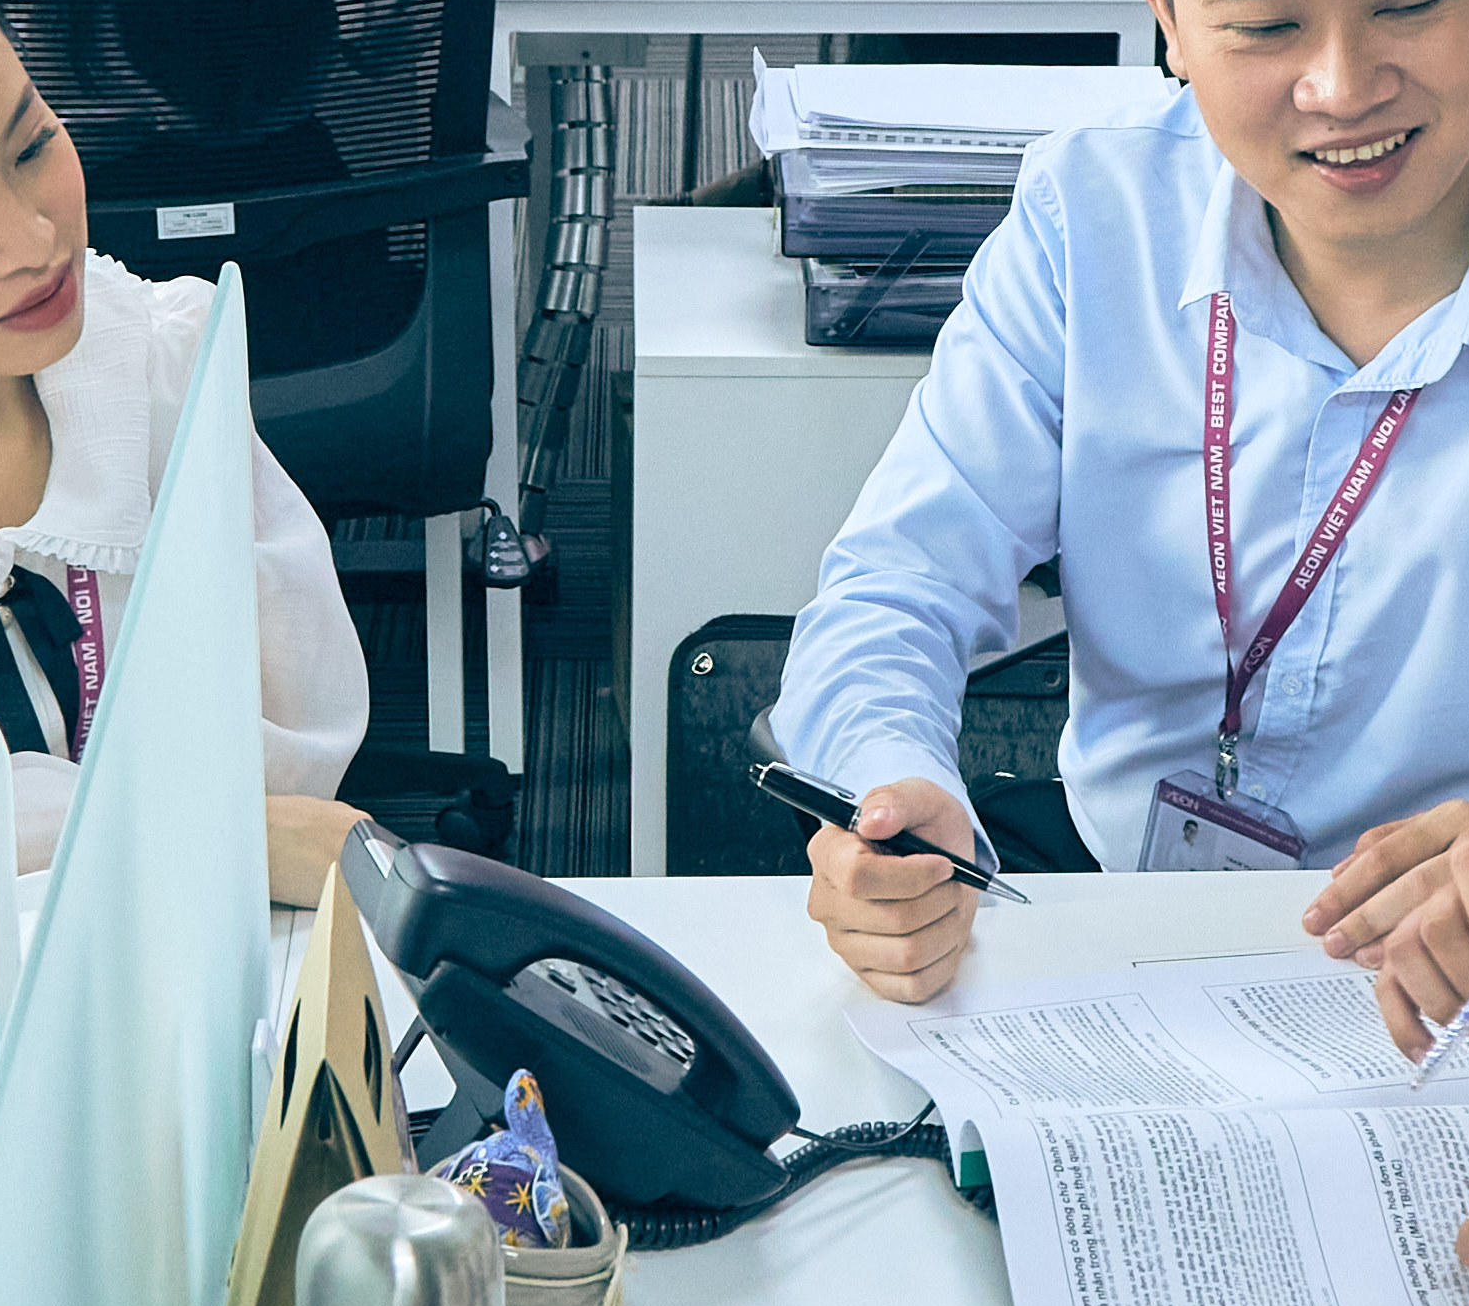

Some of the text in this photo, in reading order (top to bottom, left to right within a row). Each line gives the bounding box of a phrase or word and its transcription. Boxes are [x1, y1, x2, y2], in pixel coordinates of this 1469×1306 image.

[1210, 292, 1229, 594] AEON VIET NAM BEST COMPAN
[1294, 542, 1328, 590] AEON
[1341, 458, 1375, 504] NAM
[82, 641, 99, 690] NAM
[1079, 1213, 1093, 1235] khu
[1084, 1238, 1101, 1269] trong
